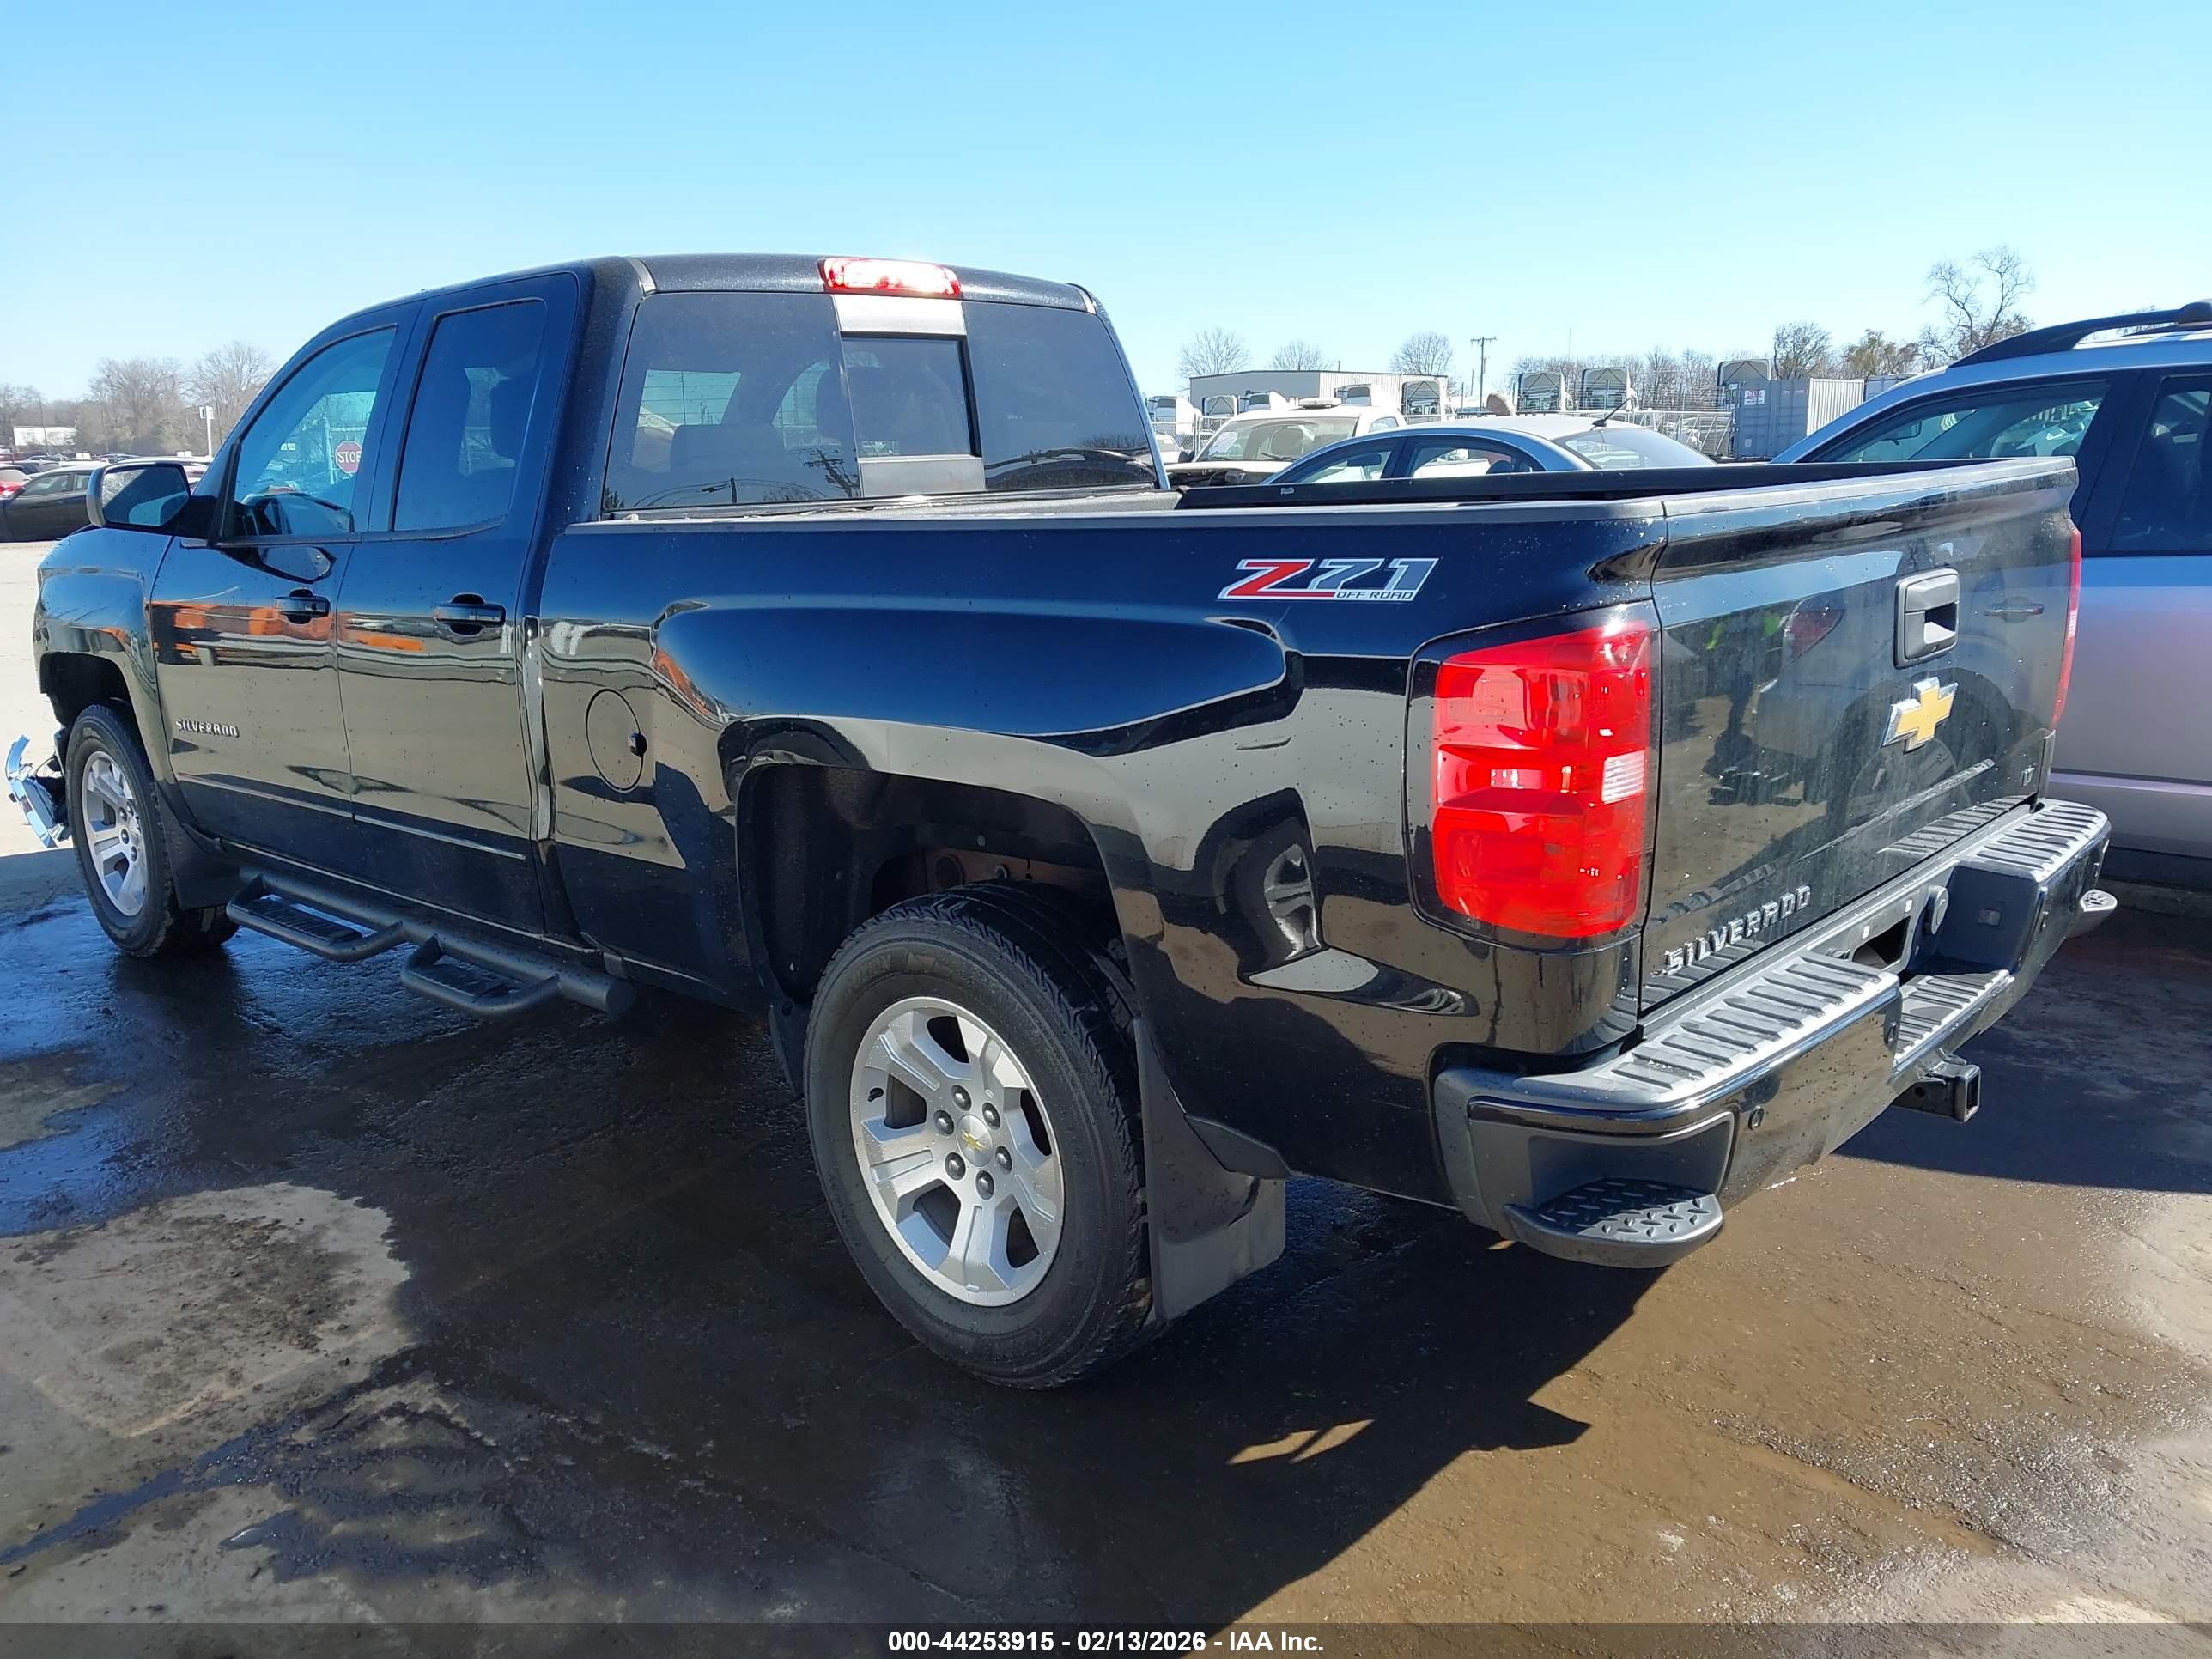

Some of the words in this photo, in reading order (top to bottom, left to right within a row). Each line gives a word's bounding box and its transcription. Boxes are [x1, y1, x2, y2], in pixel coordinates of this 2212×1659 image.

[1218, 558, 1439, 600] Z71
[1336, 591, 1367, 599] OFF
[1370, 591, 1413, 599] ROAD
[175, 718, 239, 737] SILVERADO
[1665, 885, 1812, 976] SILVERADO
